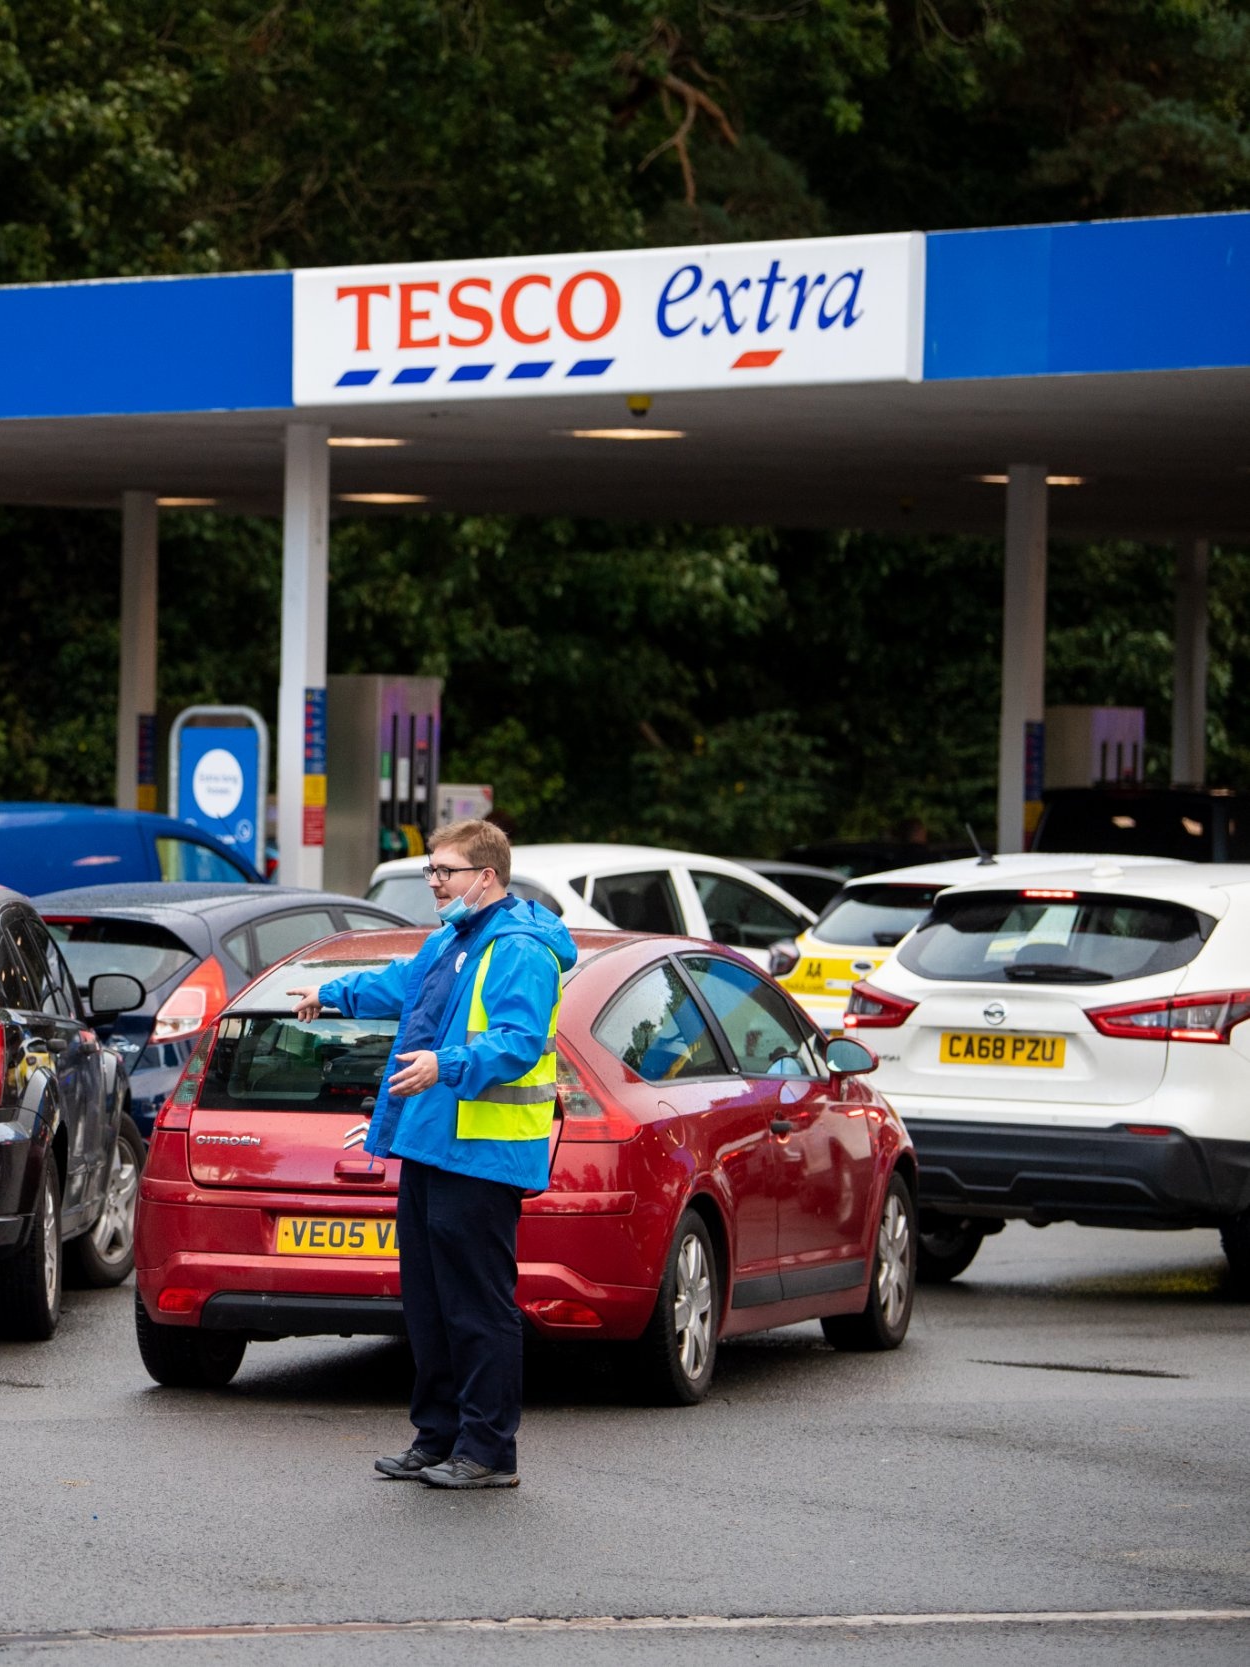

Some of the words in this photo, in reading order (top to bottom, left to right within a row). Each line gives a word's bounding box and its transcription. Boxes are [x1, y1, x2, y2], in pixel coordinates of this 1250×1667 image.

[336, 270, 622, 353] TESCO
[656, 260, 865, 340] extra
[805, 962, 822, 978] AA
[949, 1036, 1005, 1060] CA68
[1012, 1038, 1056, 1062] PZU
[196, 1135, 261, 1147] CITROËN
[292, 1221, 366, 1249] VE05
[376, 1222, 400, 1249] V
